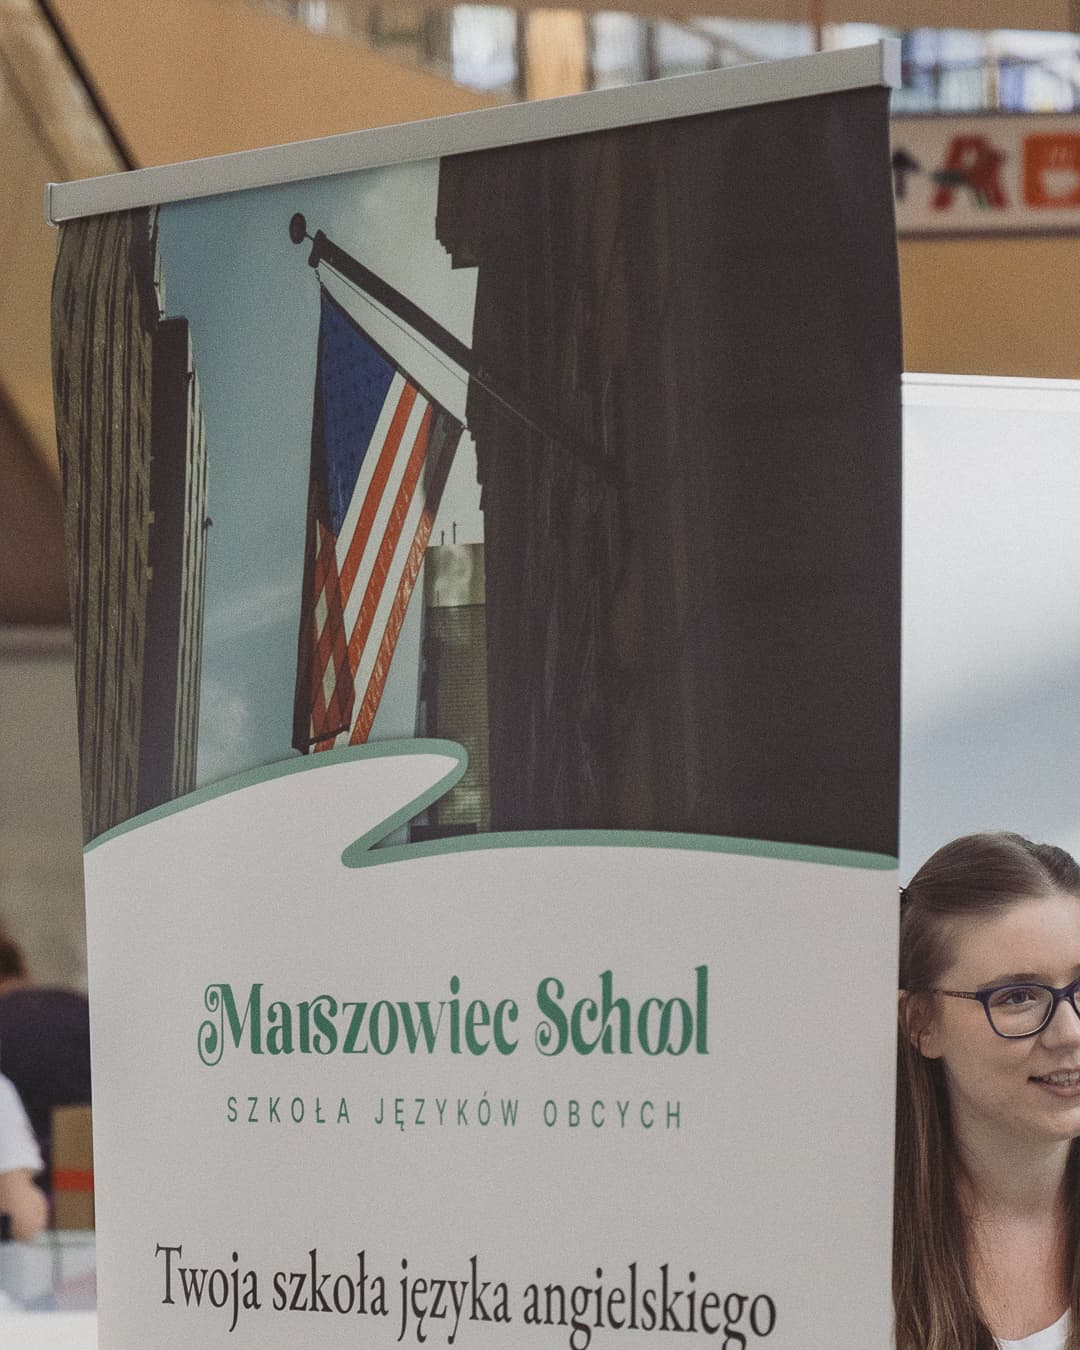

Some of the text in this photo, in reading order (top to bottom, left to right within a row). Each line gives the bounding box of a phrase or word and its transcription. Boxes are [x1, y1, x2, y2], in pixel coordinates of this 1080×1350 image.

[198, 964, 709, 1067] Marszowiec School
[226, 1091, 682, 1132] SZKOŁA JĘZYKÓW OBCYCH
[155, 1243, 262, 1333] Twoja
[272, 1248, 389, 1316] szkoła
[397, 1254, 512, 1344] języka
